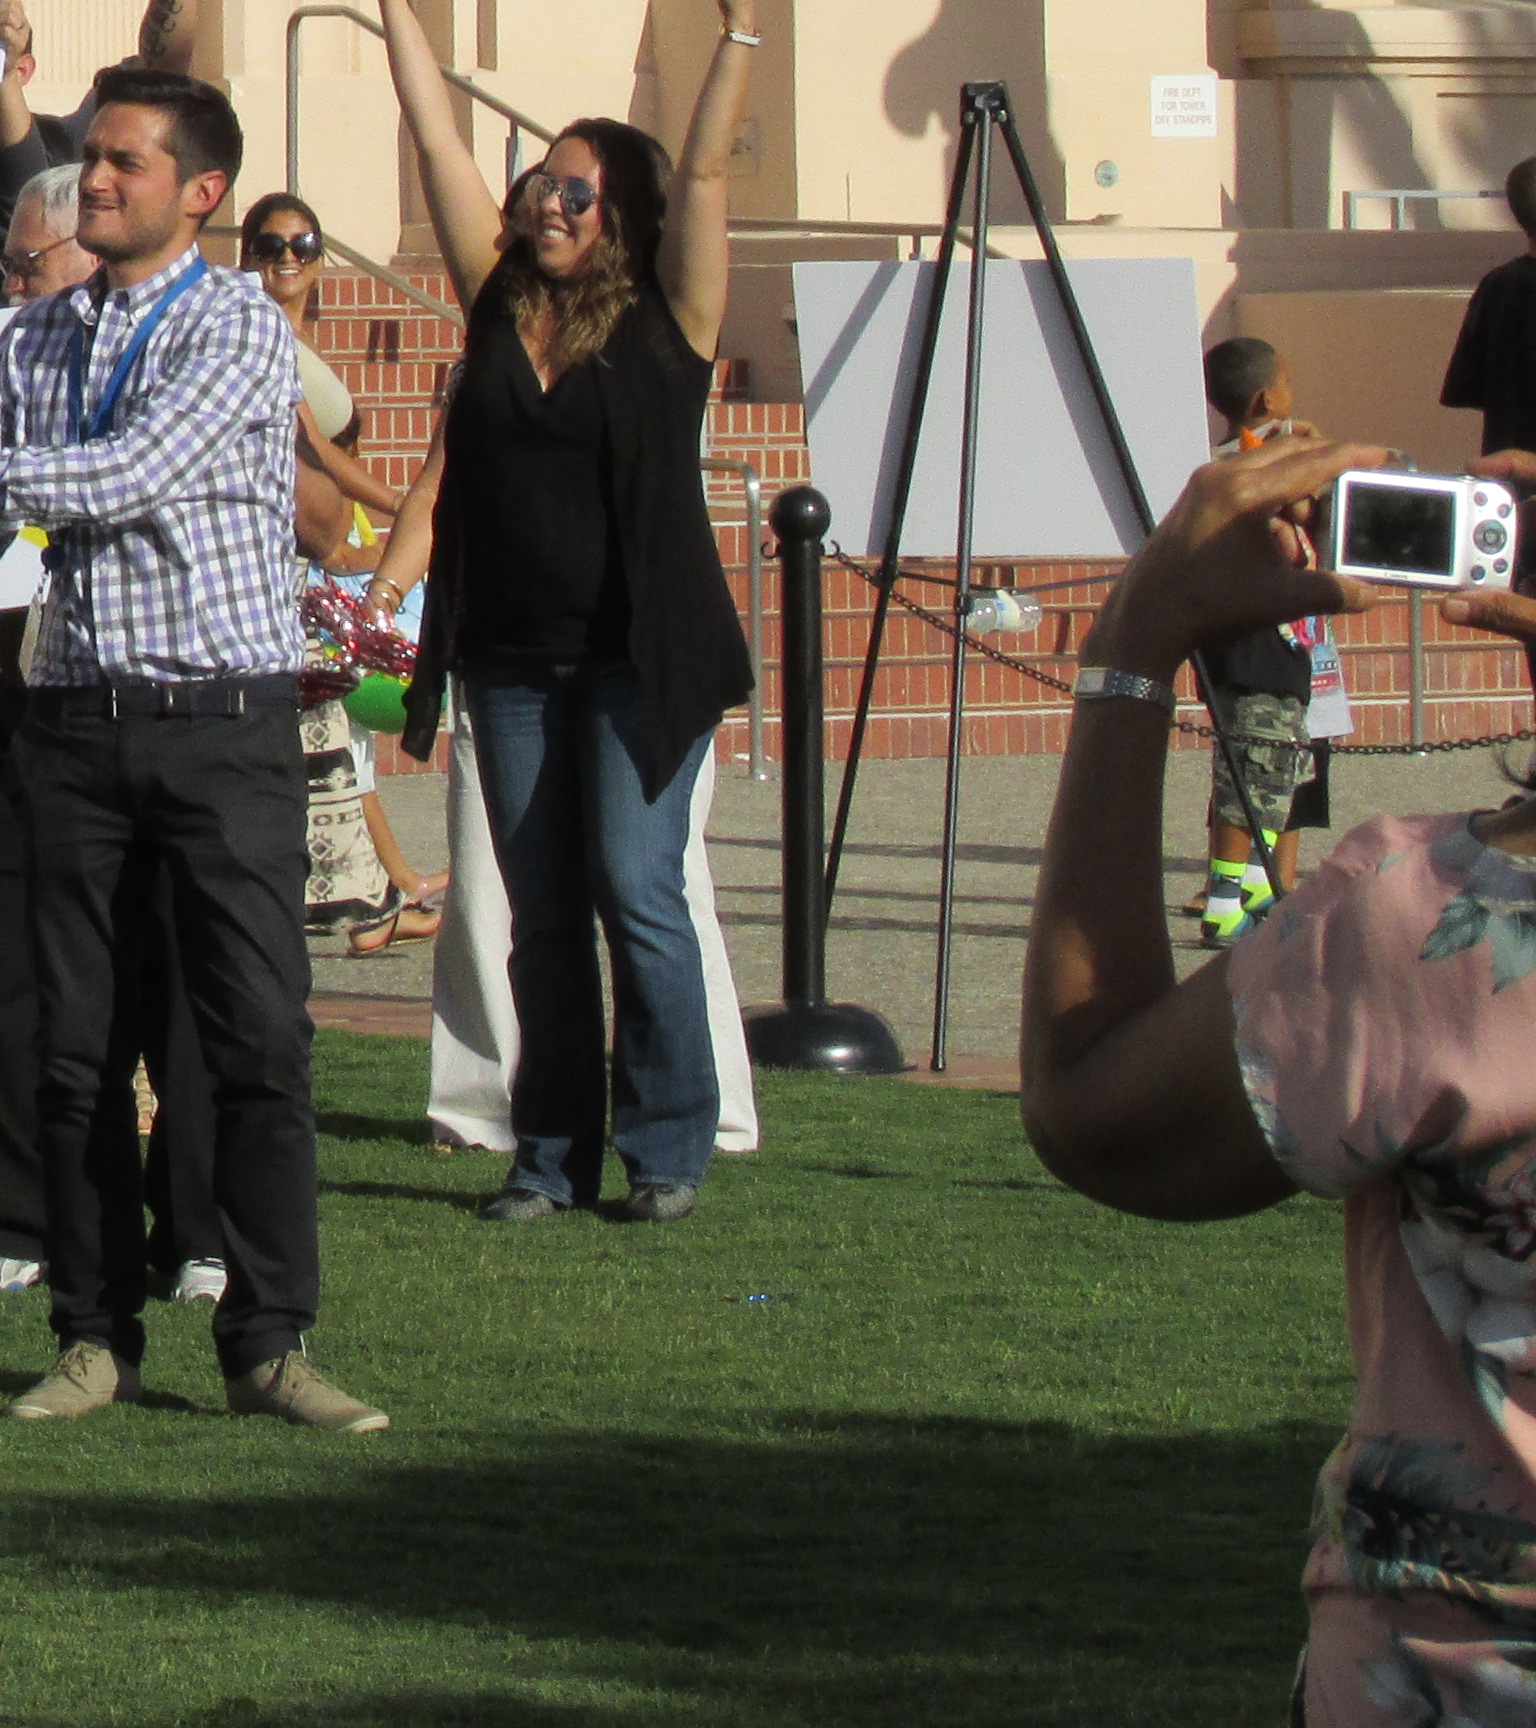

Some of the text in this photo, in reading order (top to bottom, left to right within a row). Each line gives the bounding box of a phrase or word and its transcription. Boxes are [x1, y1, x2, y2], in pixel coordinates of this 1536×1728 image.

[1163, 88, 1179, 97] FIRE
[1161, 101, 1206, 110] FOR TOWER
